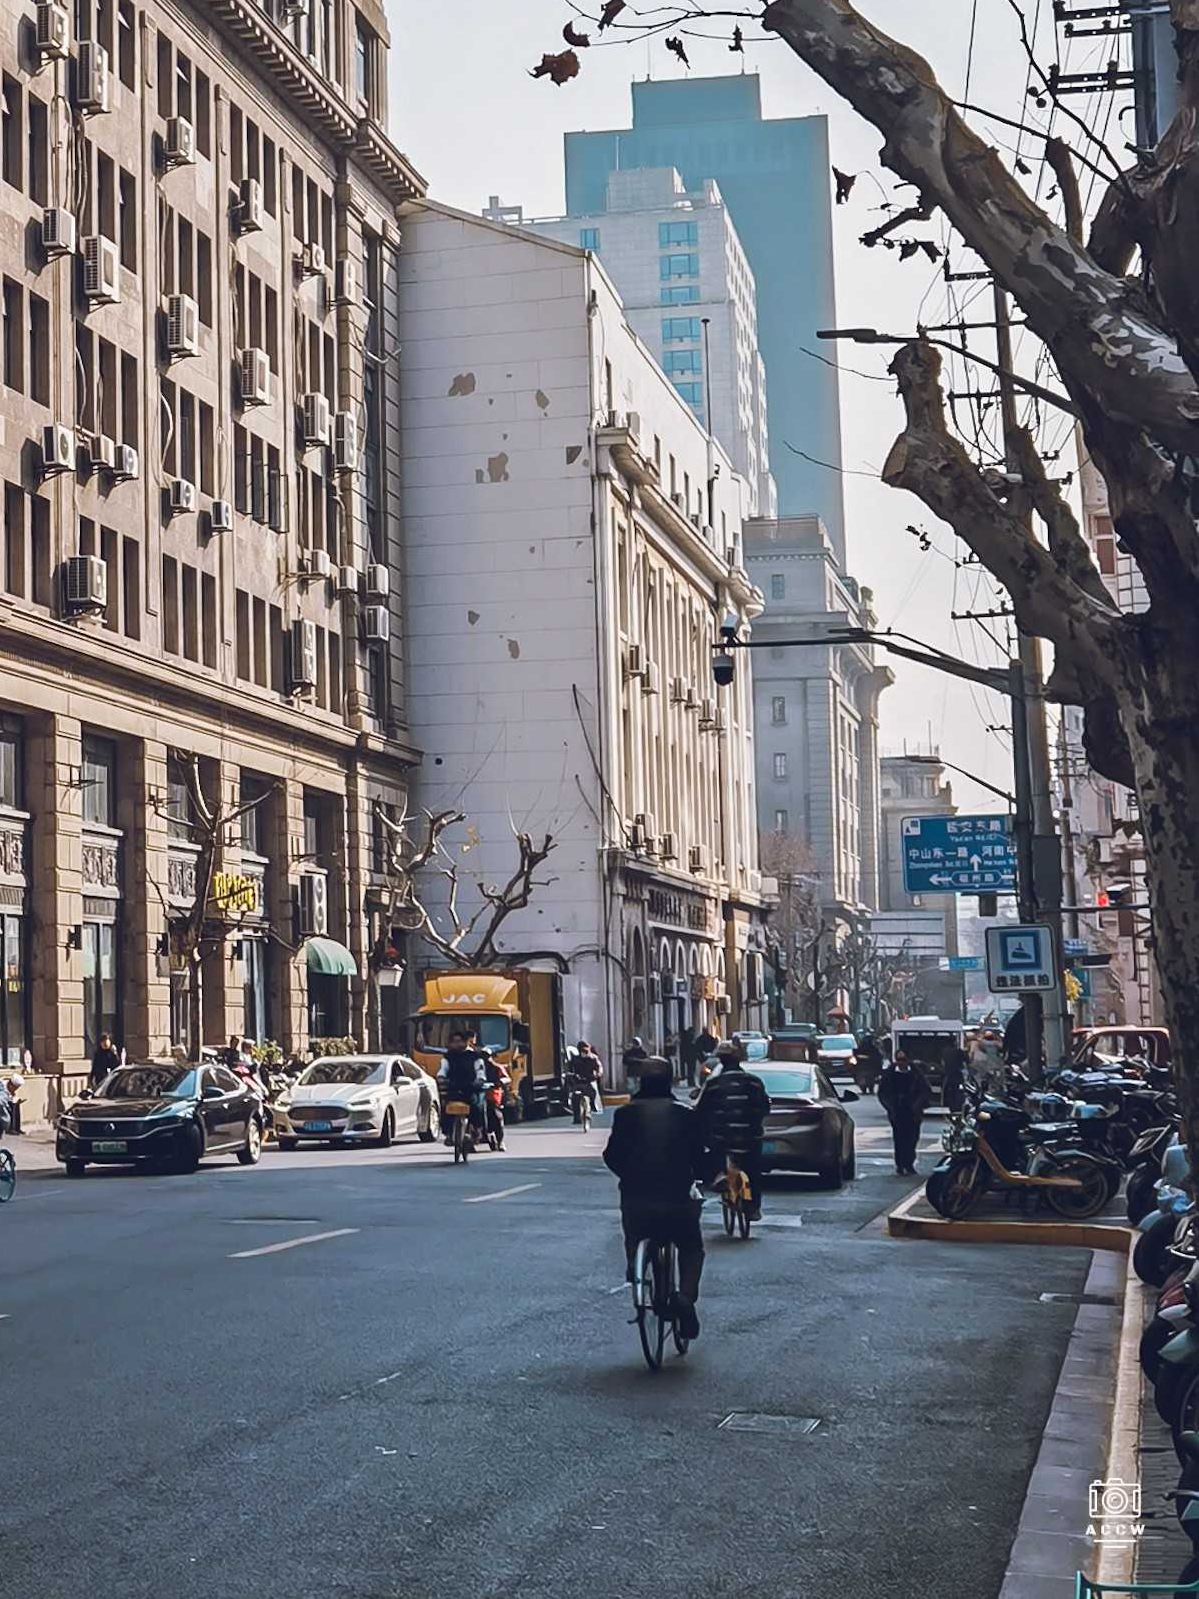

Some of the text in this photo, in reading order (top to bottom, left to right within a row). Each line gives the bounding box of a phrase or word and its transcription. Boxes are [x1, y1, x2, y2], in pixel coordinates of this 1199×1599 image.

[909, 846, 968, 860] 中山东一路
[442, 993, 487, 1004] JAC
